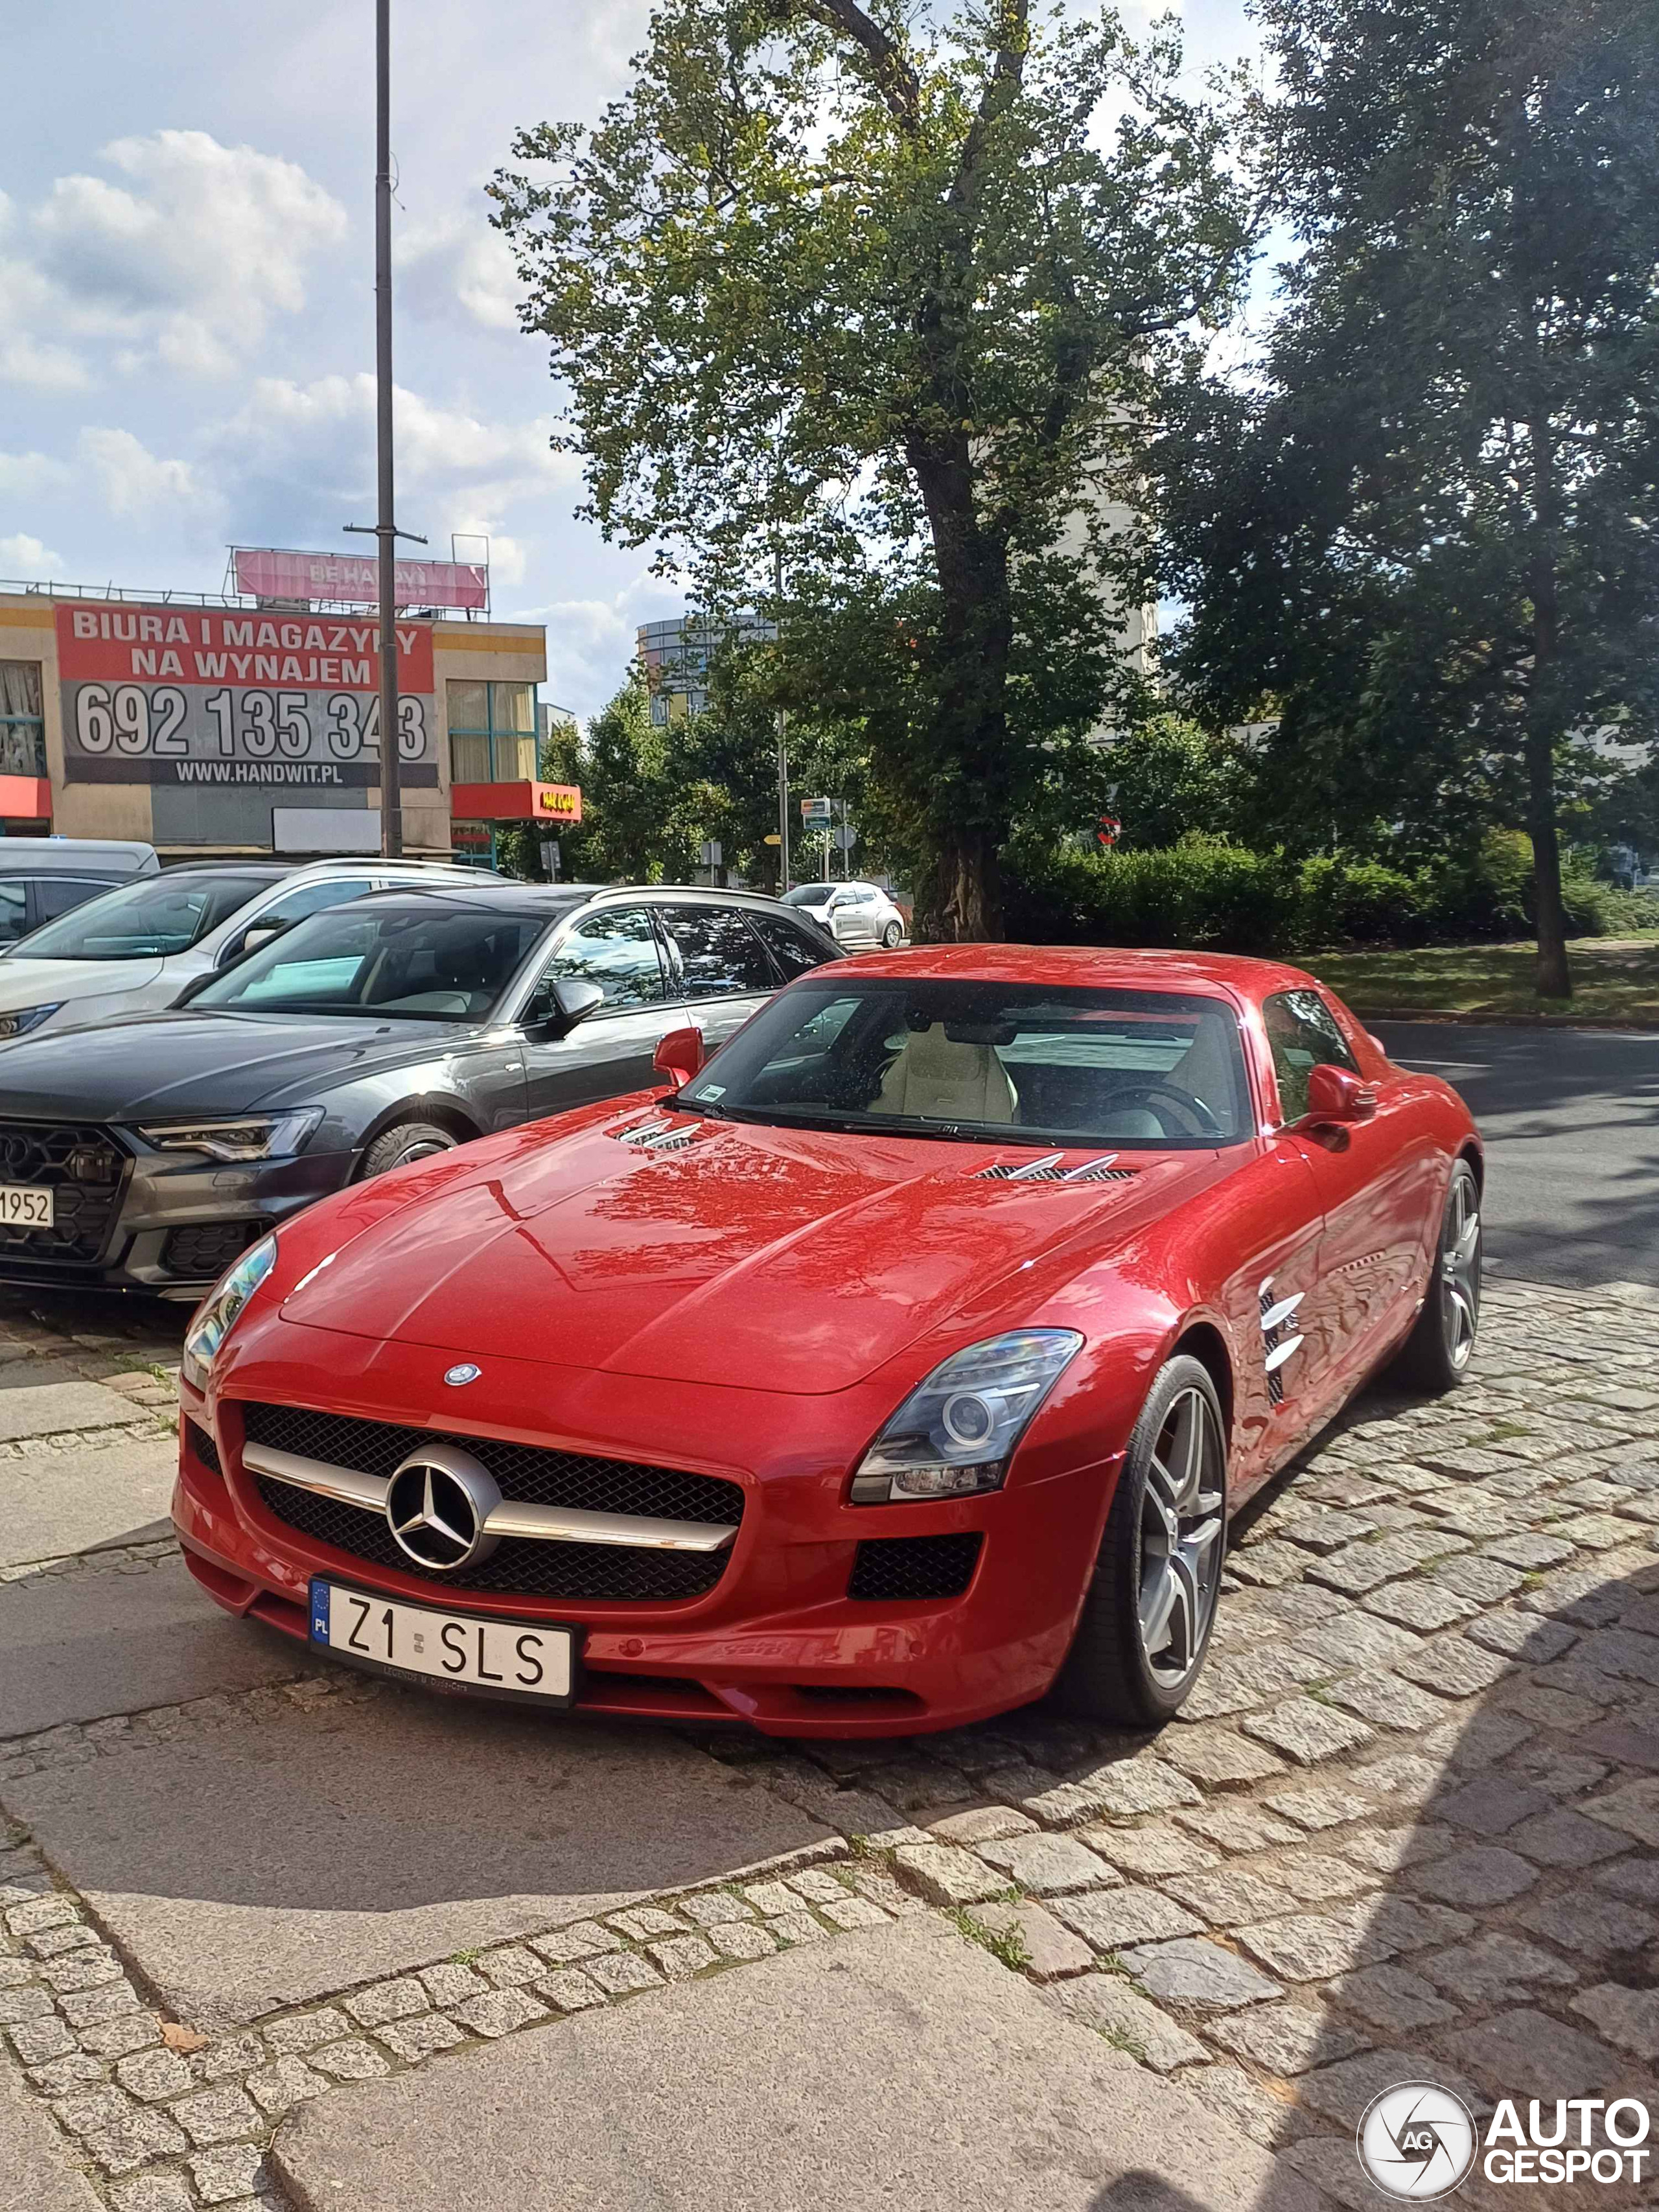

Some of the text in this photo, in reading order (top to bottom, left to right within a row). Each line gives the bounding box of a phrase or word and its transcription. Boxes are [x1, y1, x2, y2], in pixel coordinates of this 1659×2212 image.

[310, 565, 338, 583] BE
[73, 611, 191, 644] BIURA
[201, 619, 211, 644] I
[132, 648, 370, 684] NA WYNAJEM
[76, 683, 189, 755] 692
[205, 688, 311, 758] 135
[176, 762, 343, 784] WWW.HANDWIT.PL
[315, 1618, 328, 1635] PL
[349, 1598, 544, 1685] Z1 SLS
